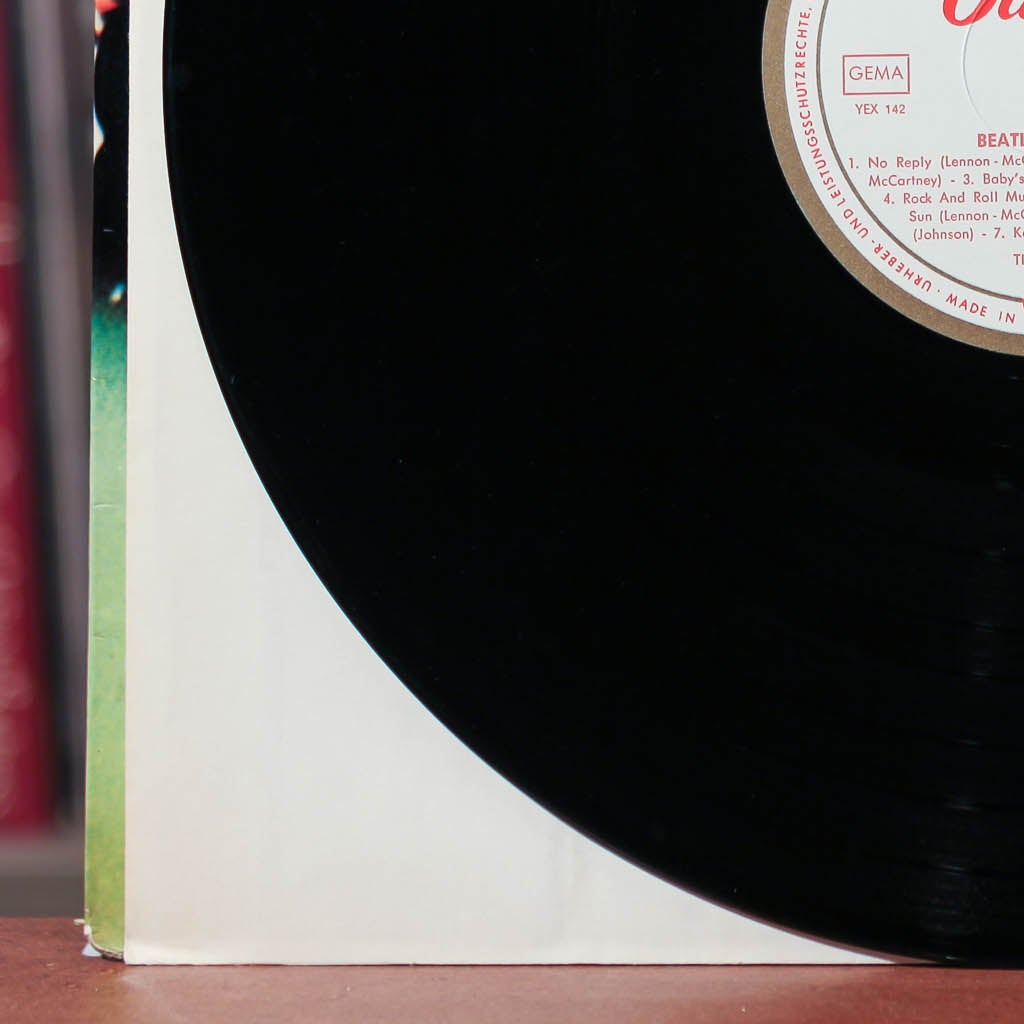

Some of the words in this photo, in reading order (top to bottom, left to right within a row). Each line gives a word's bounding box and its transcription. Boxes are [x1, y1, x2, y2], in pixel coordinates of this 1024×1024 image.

[849, 66, 904, 80] GEMA
[855, 104, 878, 115] YEX
[886, 104, 905, 114] 142
[849, 158, 859, 168] 1.
[868, 157, 887, 168] No
[897, 156, 931, 170] Reply
[869, 174, 941, 188] McCartney)
[963, 174, 974, 185] 3.
[983, 172, 1024, 186] Baby's
[883, 193, 895, 204] 4.
[904, 192, 932, 204] Rock
[940, 192, 965, 203] And
[974, 191, 997, 203] Roll
[909, 210, 932, 222] Sun
[843, 209, 868, 239] UND
[914, 227, 973, 242] (Johnson)
[994, 227, 1005, 239] 7.
[872, 240, 931, 292] URHEBER-
[946, 293, 987, 317] MADE
[999, 311, 1015, 324] IN
